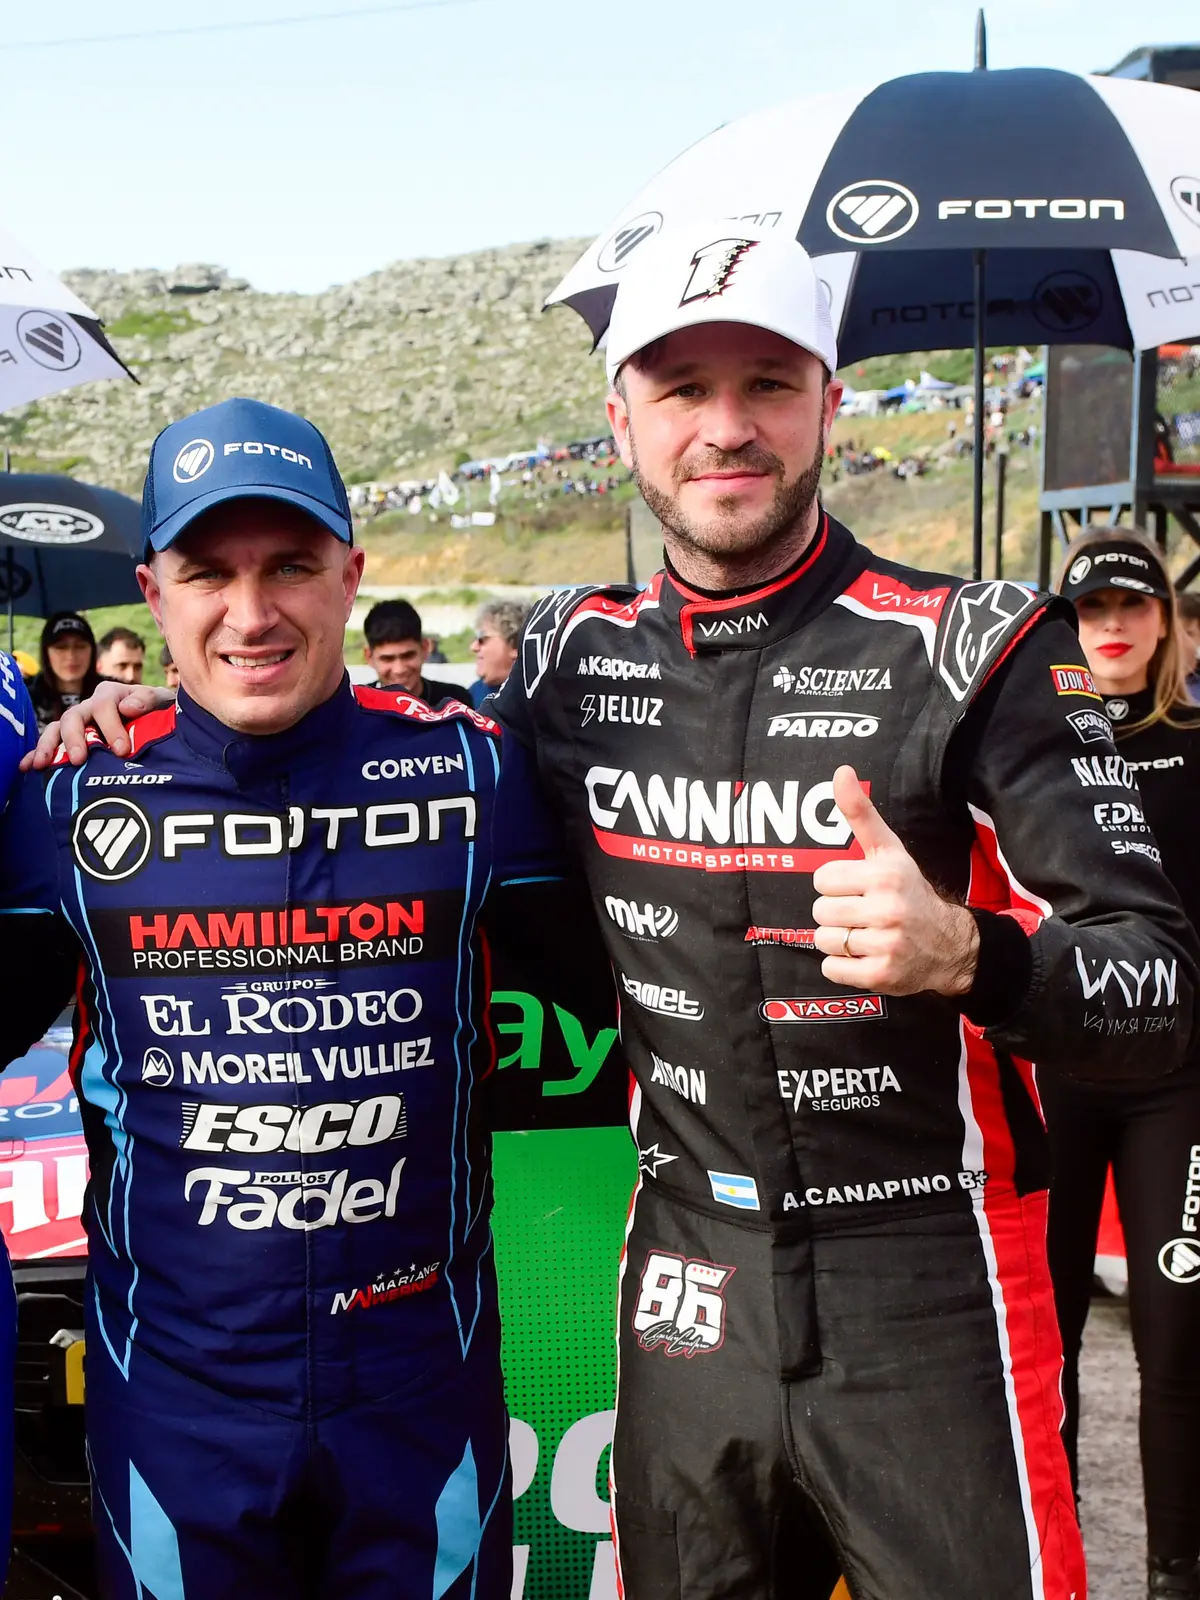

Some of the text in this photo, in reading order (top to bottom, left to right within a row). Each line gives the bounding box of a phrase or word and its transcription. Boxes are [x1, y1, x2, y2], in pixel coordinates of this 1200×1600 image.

[938, 199, 1125, 220] FOTON
[223, 442, 313, 470] FOTON
[1094, 552, 1149, 570] FOTON
[698, 612, 769, 638] VAYM
[588, 655, 650, 681] Kappa
[795, 666, 892, 692] SCIENZA
[597, 694, 664, 727] JELUZ
[767, 718, 879, 738] PARDO
[85, 774, 173, 787] DUNLOP
[361, 753, 464, 781] CORVEN
[1070, 755, 1140, 791] NAHU
[584, 765, 855, 846] CANNING
[163, 796, 477, 858] FOTON
[632, 843, 795, 868] MOTORSPORTS
[129, 900, 425, 950] HAMILTON
[744, 925, 817, 944] AUTOM
[133, 936, 424, 970] PROFESSIONAL BRAND
[250, 978, 315, 992] GRUPO
[140, 988, 423, 1036] EL RODEO
[794, 999, 878, 1018] TACSA
[312, 1037, 435, 1082] VULLIEZ
[776, 1065, 902, 1113] EXPERTA
[811, 1095, 881, 1112] SEGUROS
[182, 1095, 404, 1154] ESCO
[259, 1173, 328, 1184] POLLOS
[782, 1170, 989, 1212] A.CANAPINO B+
[184, 1157, 407, 1232] Fadel
[372, 1261, 440, 1294] MARIANO
[633, 1252, 729, 1347] 86
